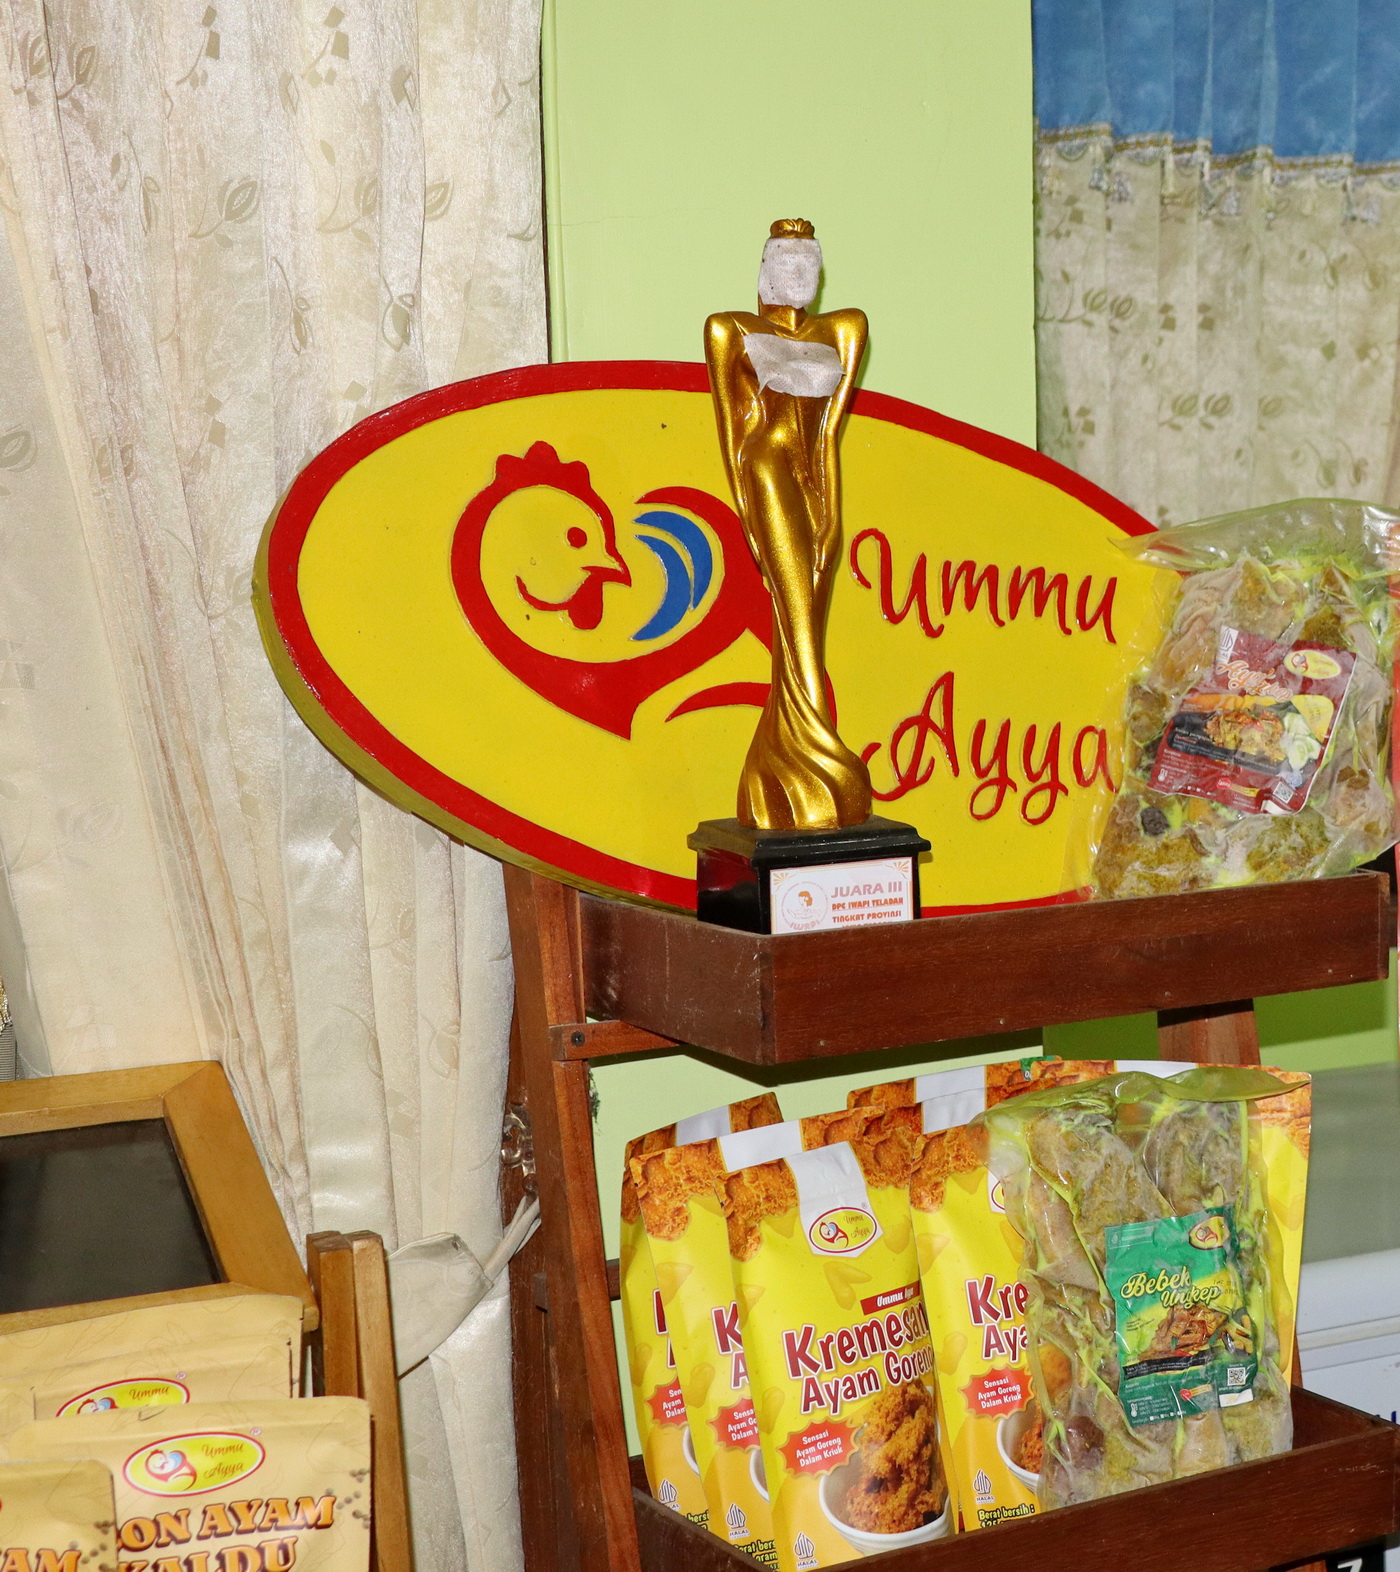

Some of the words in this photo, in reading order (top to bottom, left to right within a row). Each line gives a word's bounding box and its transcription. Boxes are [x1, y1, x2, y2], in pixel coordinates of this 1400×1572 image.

[850, 527, 1118, 644] Ummu
[861, 671, 1120, 825] Ayya
[831, 883, 884, 898] JUARA
[888, 881, 902, 893] III
[832, 914, 865, 924] TINGKAT
[867, 910, 902, 920] PROVINSI
[1121, 1266, 1191, 1298] Bebek
[1161, 1286, 1221, 1309] Ungkep
[783, 1301, 930, 1379] Kremesan
[983, 1376, 1009, 1388] Sensasi
[129, 1386, 169, 1400] Ummu
[801, 1367, 881, 1415] Ayam
[978, 1391, 997, 1400] Ayam
[998, 1385, 1021, 1394] Goreng
[662, 1399, 681, 1410] Ayam
[981, 1399, 1002, 1409] Dalam
[1003, 1393, 1022, 1403] Kriuk
[728, 1420, 747, 1432] Ayam
[731, 1429, 754, 1441] Dalam
[802, 1430, 829, 1445] Sensasi
[201, 1443, 244, 1457] Ummu
[796, 1446, 816, 1459] Ayam
[817, 1437, 842, 1450] Goreng
[800, 1454, 822, 1467] Dalam
[823, 1445, 844, 1458] Kriuk
[203, 1462, 244, 1479] Ayya
[200, 1496, 337, 1539] AYAM
[978, 1509, 1001, 1521] Berat
[1002, 1504, 1029, 1518] bersih
